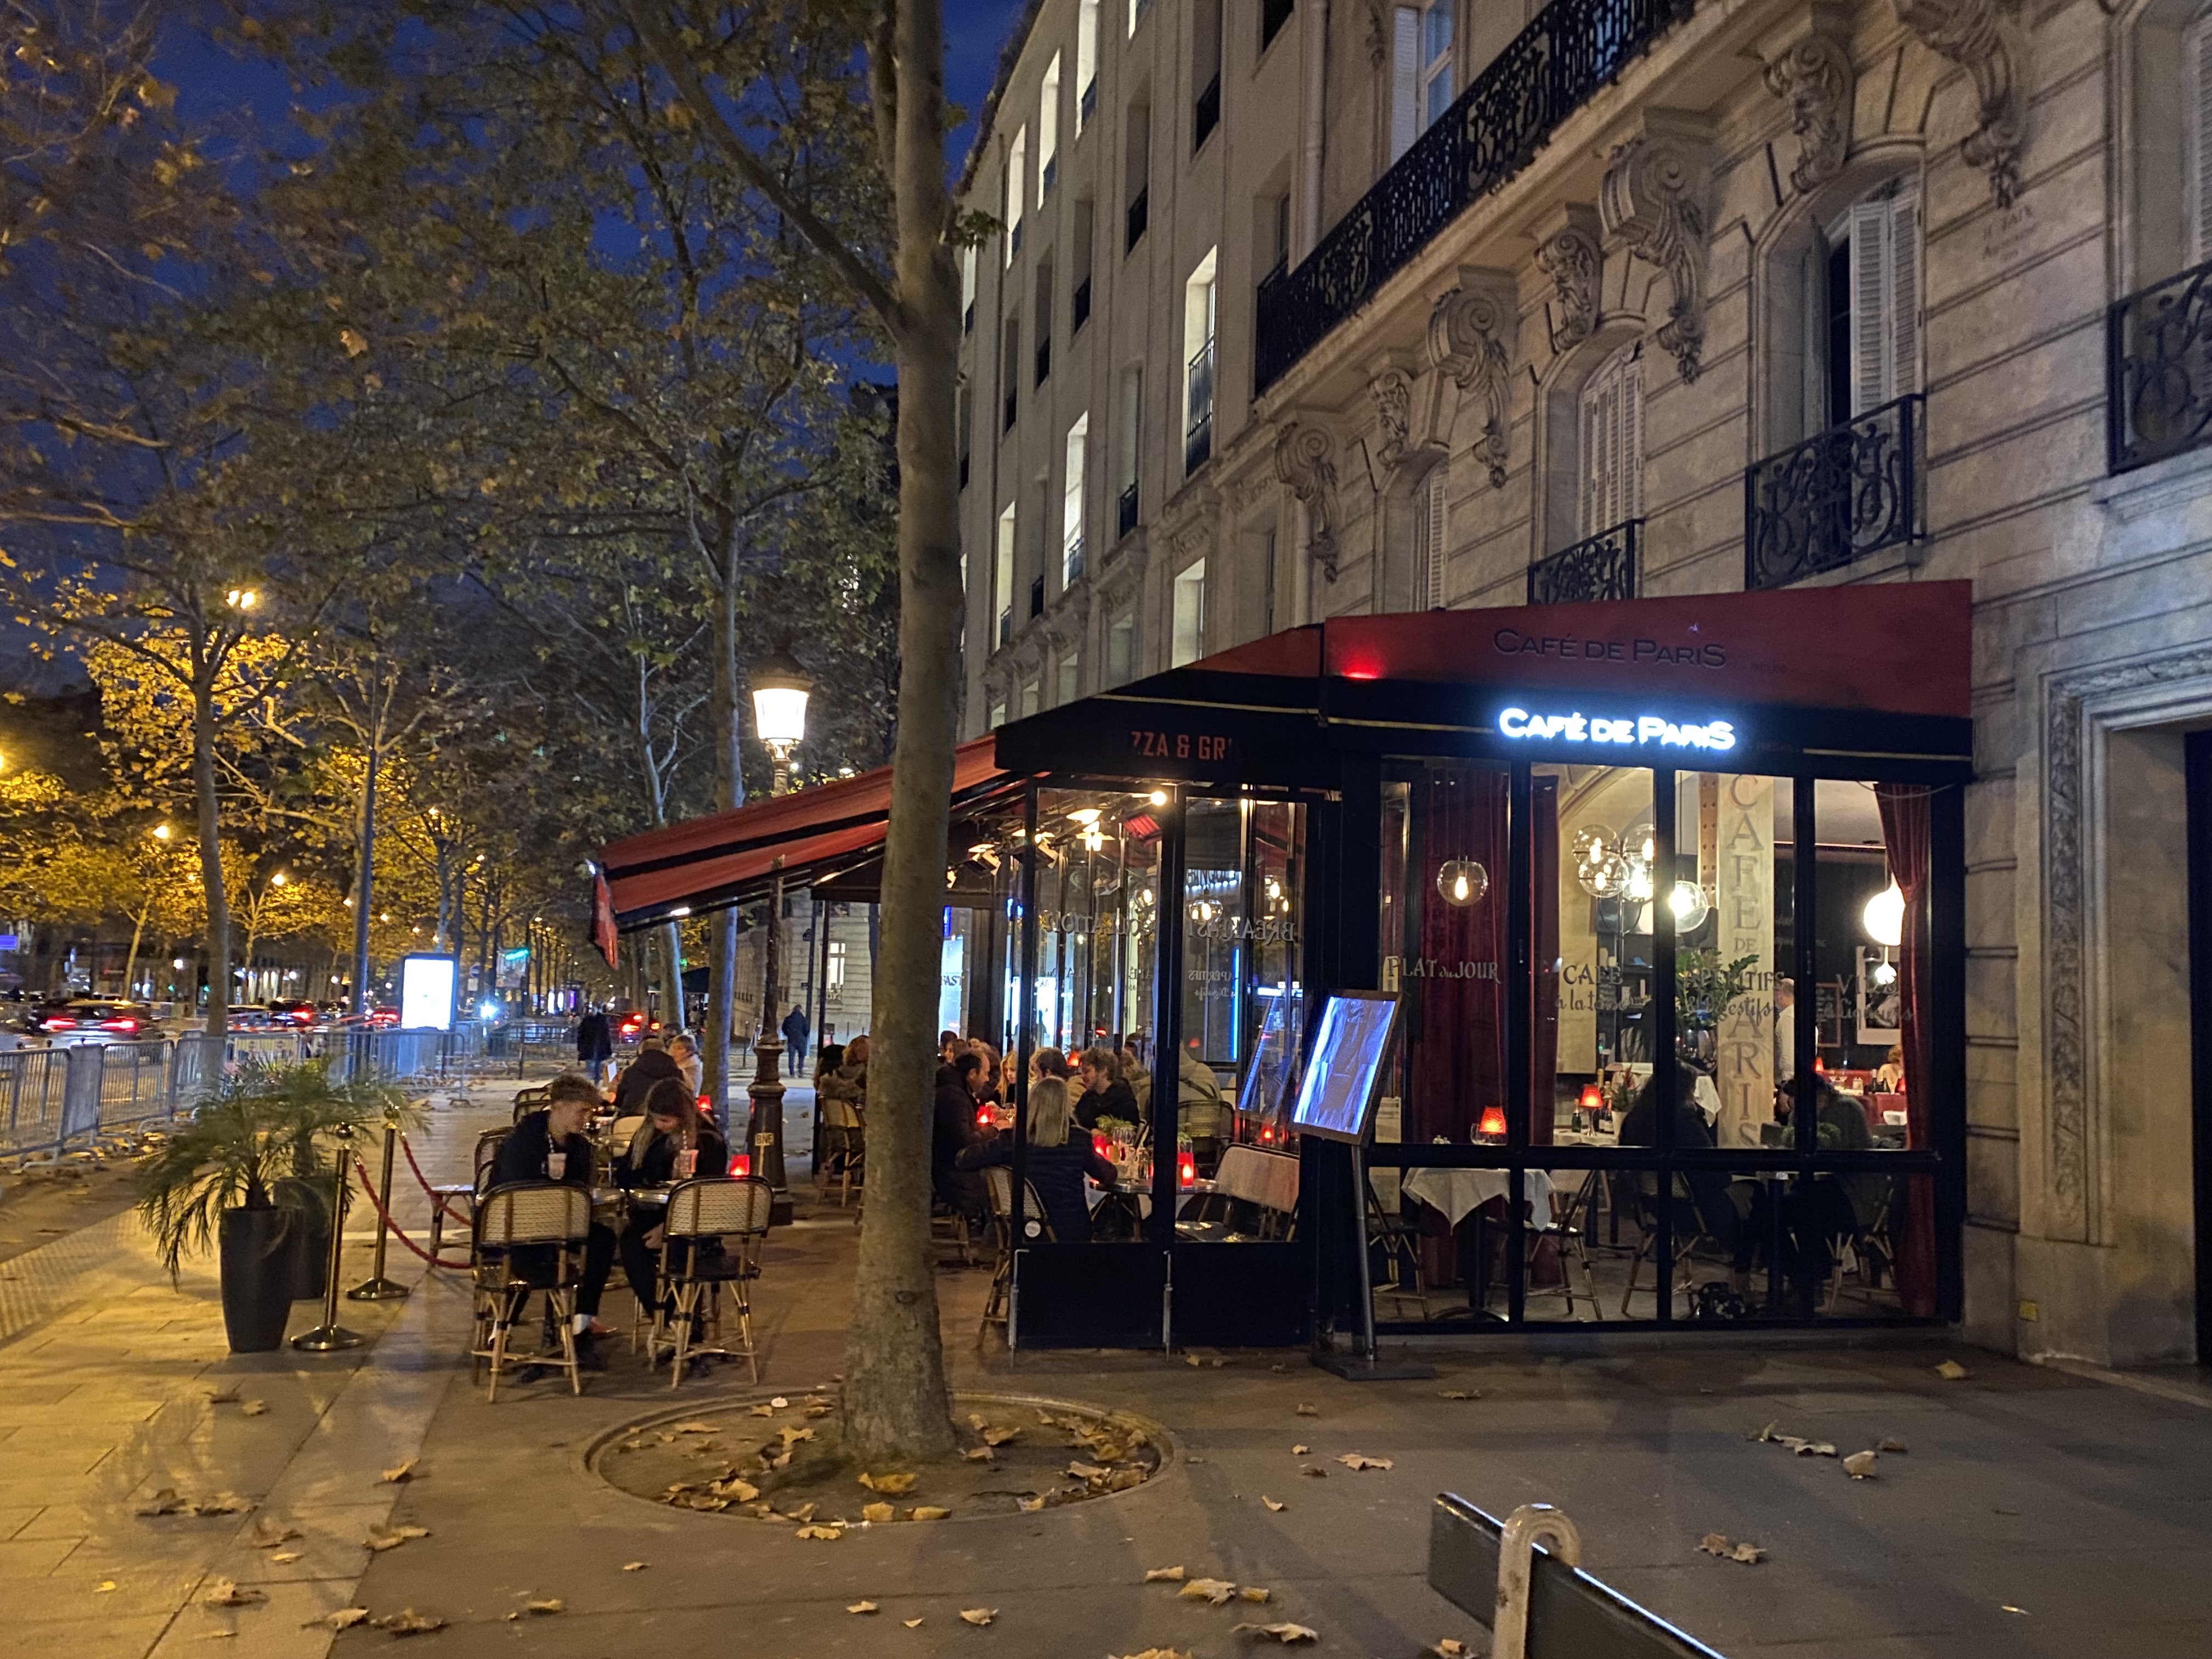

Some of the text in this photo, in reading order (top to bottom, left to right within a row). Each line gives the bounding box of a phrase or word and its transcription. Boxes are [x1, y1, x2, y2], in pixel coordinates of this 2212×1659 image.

[1493, 628, 1726, 668] CAFÉ DE PARIS
[1499, 708, 1736, 749] CAFÉ DE PARIS
[1176, 734, 1190, 758] &
[1733, 937, 1758, 953] DE
[1388, 957, 1438, 978] PLAT
[1454, 961, 1502, 984] JOUR
[1570, 989, 1587, 1011] la
